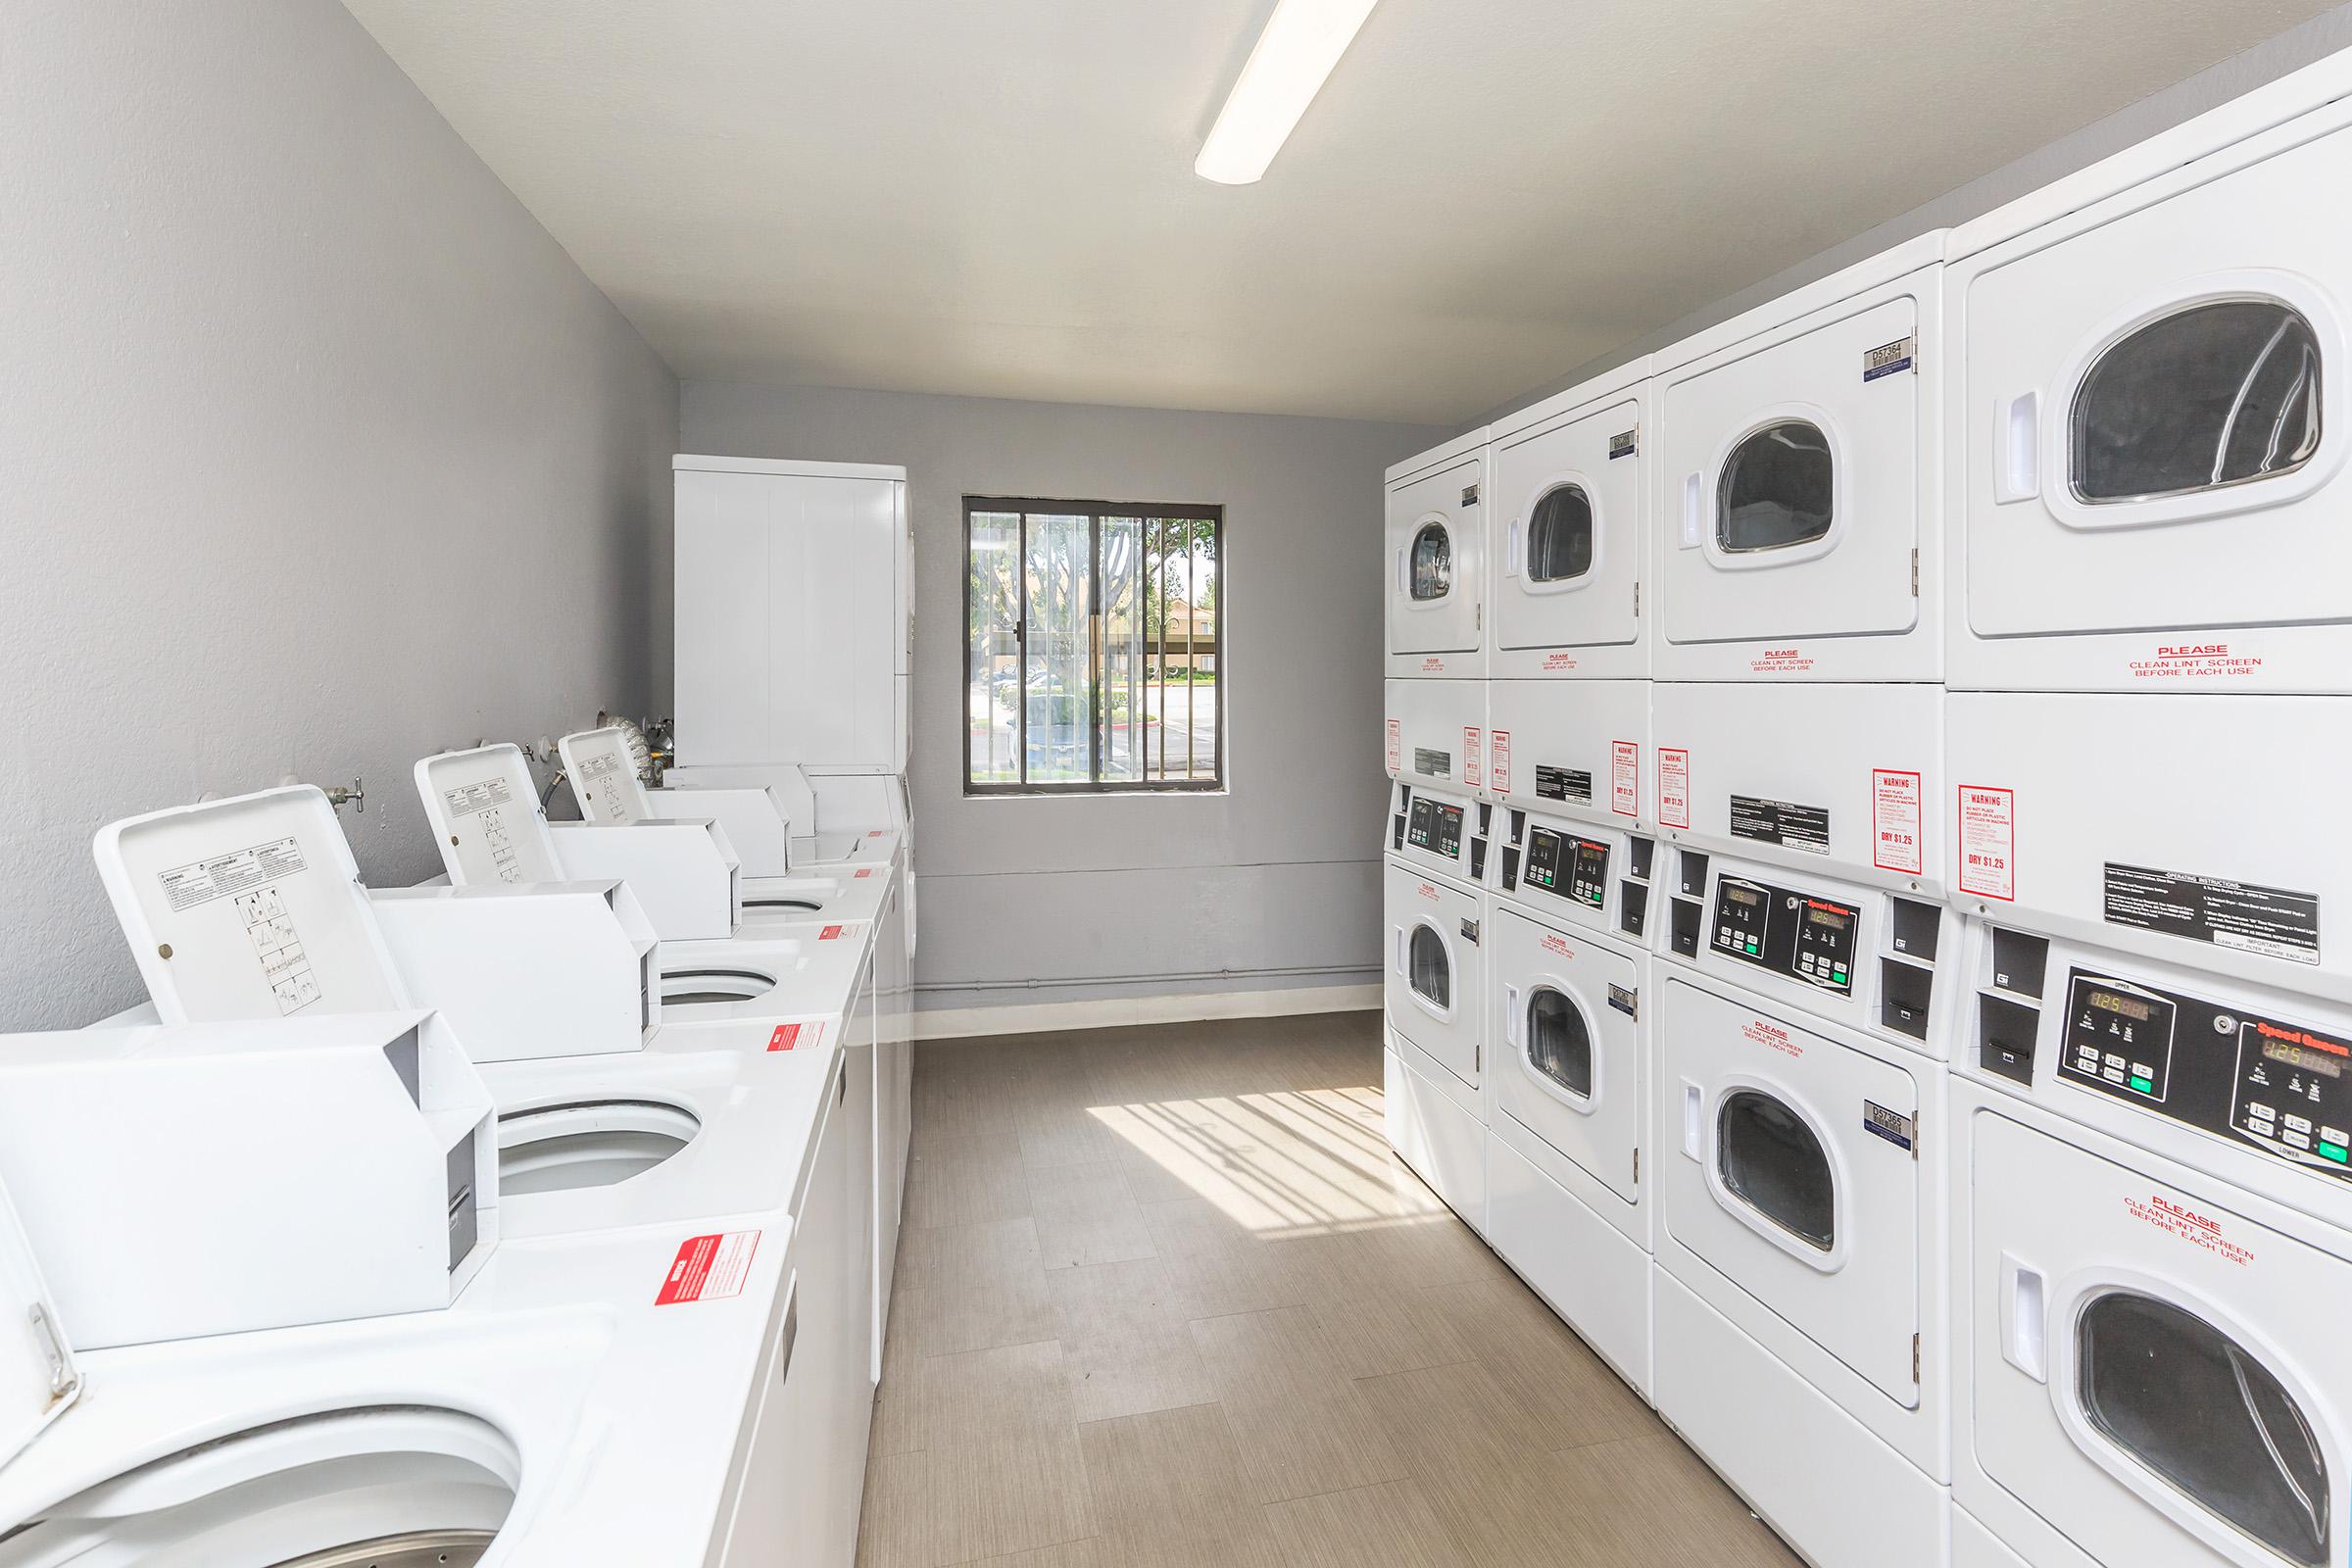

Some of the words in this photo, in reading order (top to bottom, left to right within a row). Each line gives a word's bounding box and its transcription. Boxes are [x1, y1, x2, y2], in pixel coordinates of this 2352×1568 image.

[1872, 343, 1901, 361] D57364
[2158, 645, 2228, 655] PLEASE
[1884, 778, 1909, 789] WARNING
[1971, 795, 2001, 806] WARNING
[1882, 832, 1892, 842] DRY
[1894, 834, 1912, 845] $1.25
[1969, 855, 1982, 865] DRY
[1984, 857, 2004, 869] $1.25
[2168, 872, 2196, 882] OPERATING
[2198, 877, 2238, 888] INSTRUCTIONS
[1807, 899, 1828, 910] Speed
[1828, 904, 1849, 915] Queen
[2264, 948, 2283, 956] BEFORE
[1755, 1021, 1788, 1039] PLEASE
[1741, 1025, 1761, 1036] CLEAN
[1778, 1040, 1803, 1054] SCREEN
[1743, 1032, 1766, 1045] BEFORE
[1769, 1042, 1786, 1052] EACH
[1787, 1049, 1799, 1057] USE
[2257, 1022, 2301, 1044] Speed
[2302, 1034, 2350, 1056] Queen
[2278, 1146, 2300, 1157] LOWER
[2152, 1196, 2222, 1233] PLEASE
[2125, 1198, 2164, 1220] CLEAN
[2169, 1216, 2193, 1233] LINT
[2201, 1231, 2254, 1260] SCREEN
[2130, 1207, 2176, 1234] BEFORE
[2181, 1231, 2215, 1251] EACH
[2221, 1249, 2247, 1266] USE
